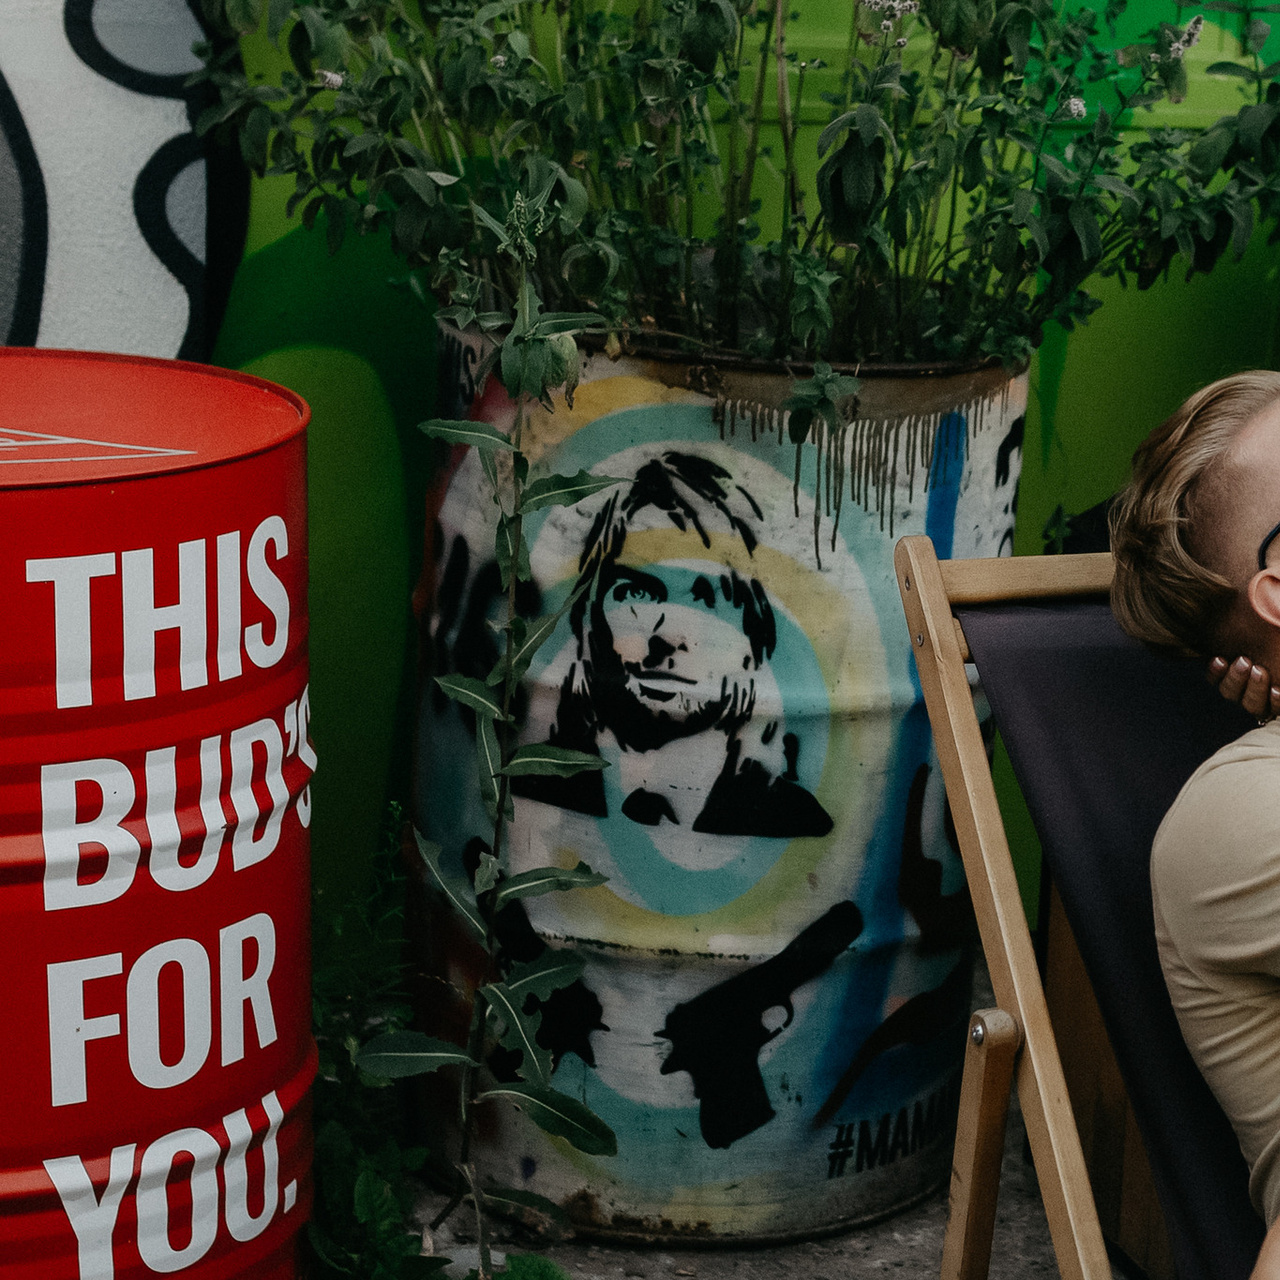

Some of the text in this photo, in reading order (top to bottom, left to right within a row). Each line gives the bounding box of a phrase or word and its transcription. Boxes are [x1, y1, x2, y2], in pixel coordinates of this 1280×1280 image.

[26, 515, 290, 709] THIS
[41, 683, 318, 911] BUD'S
[47, 912, 278, 1108] FOR
